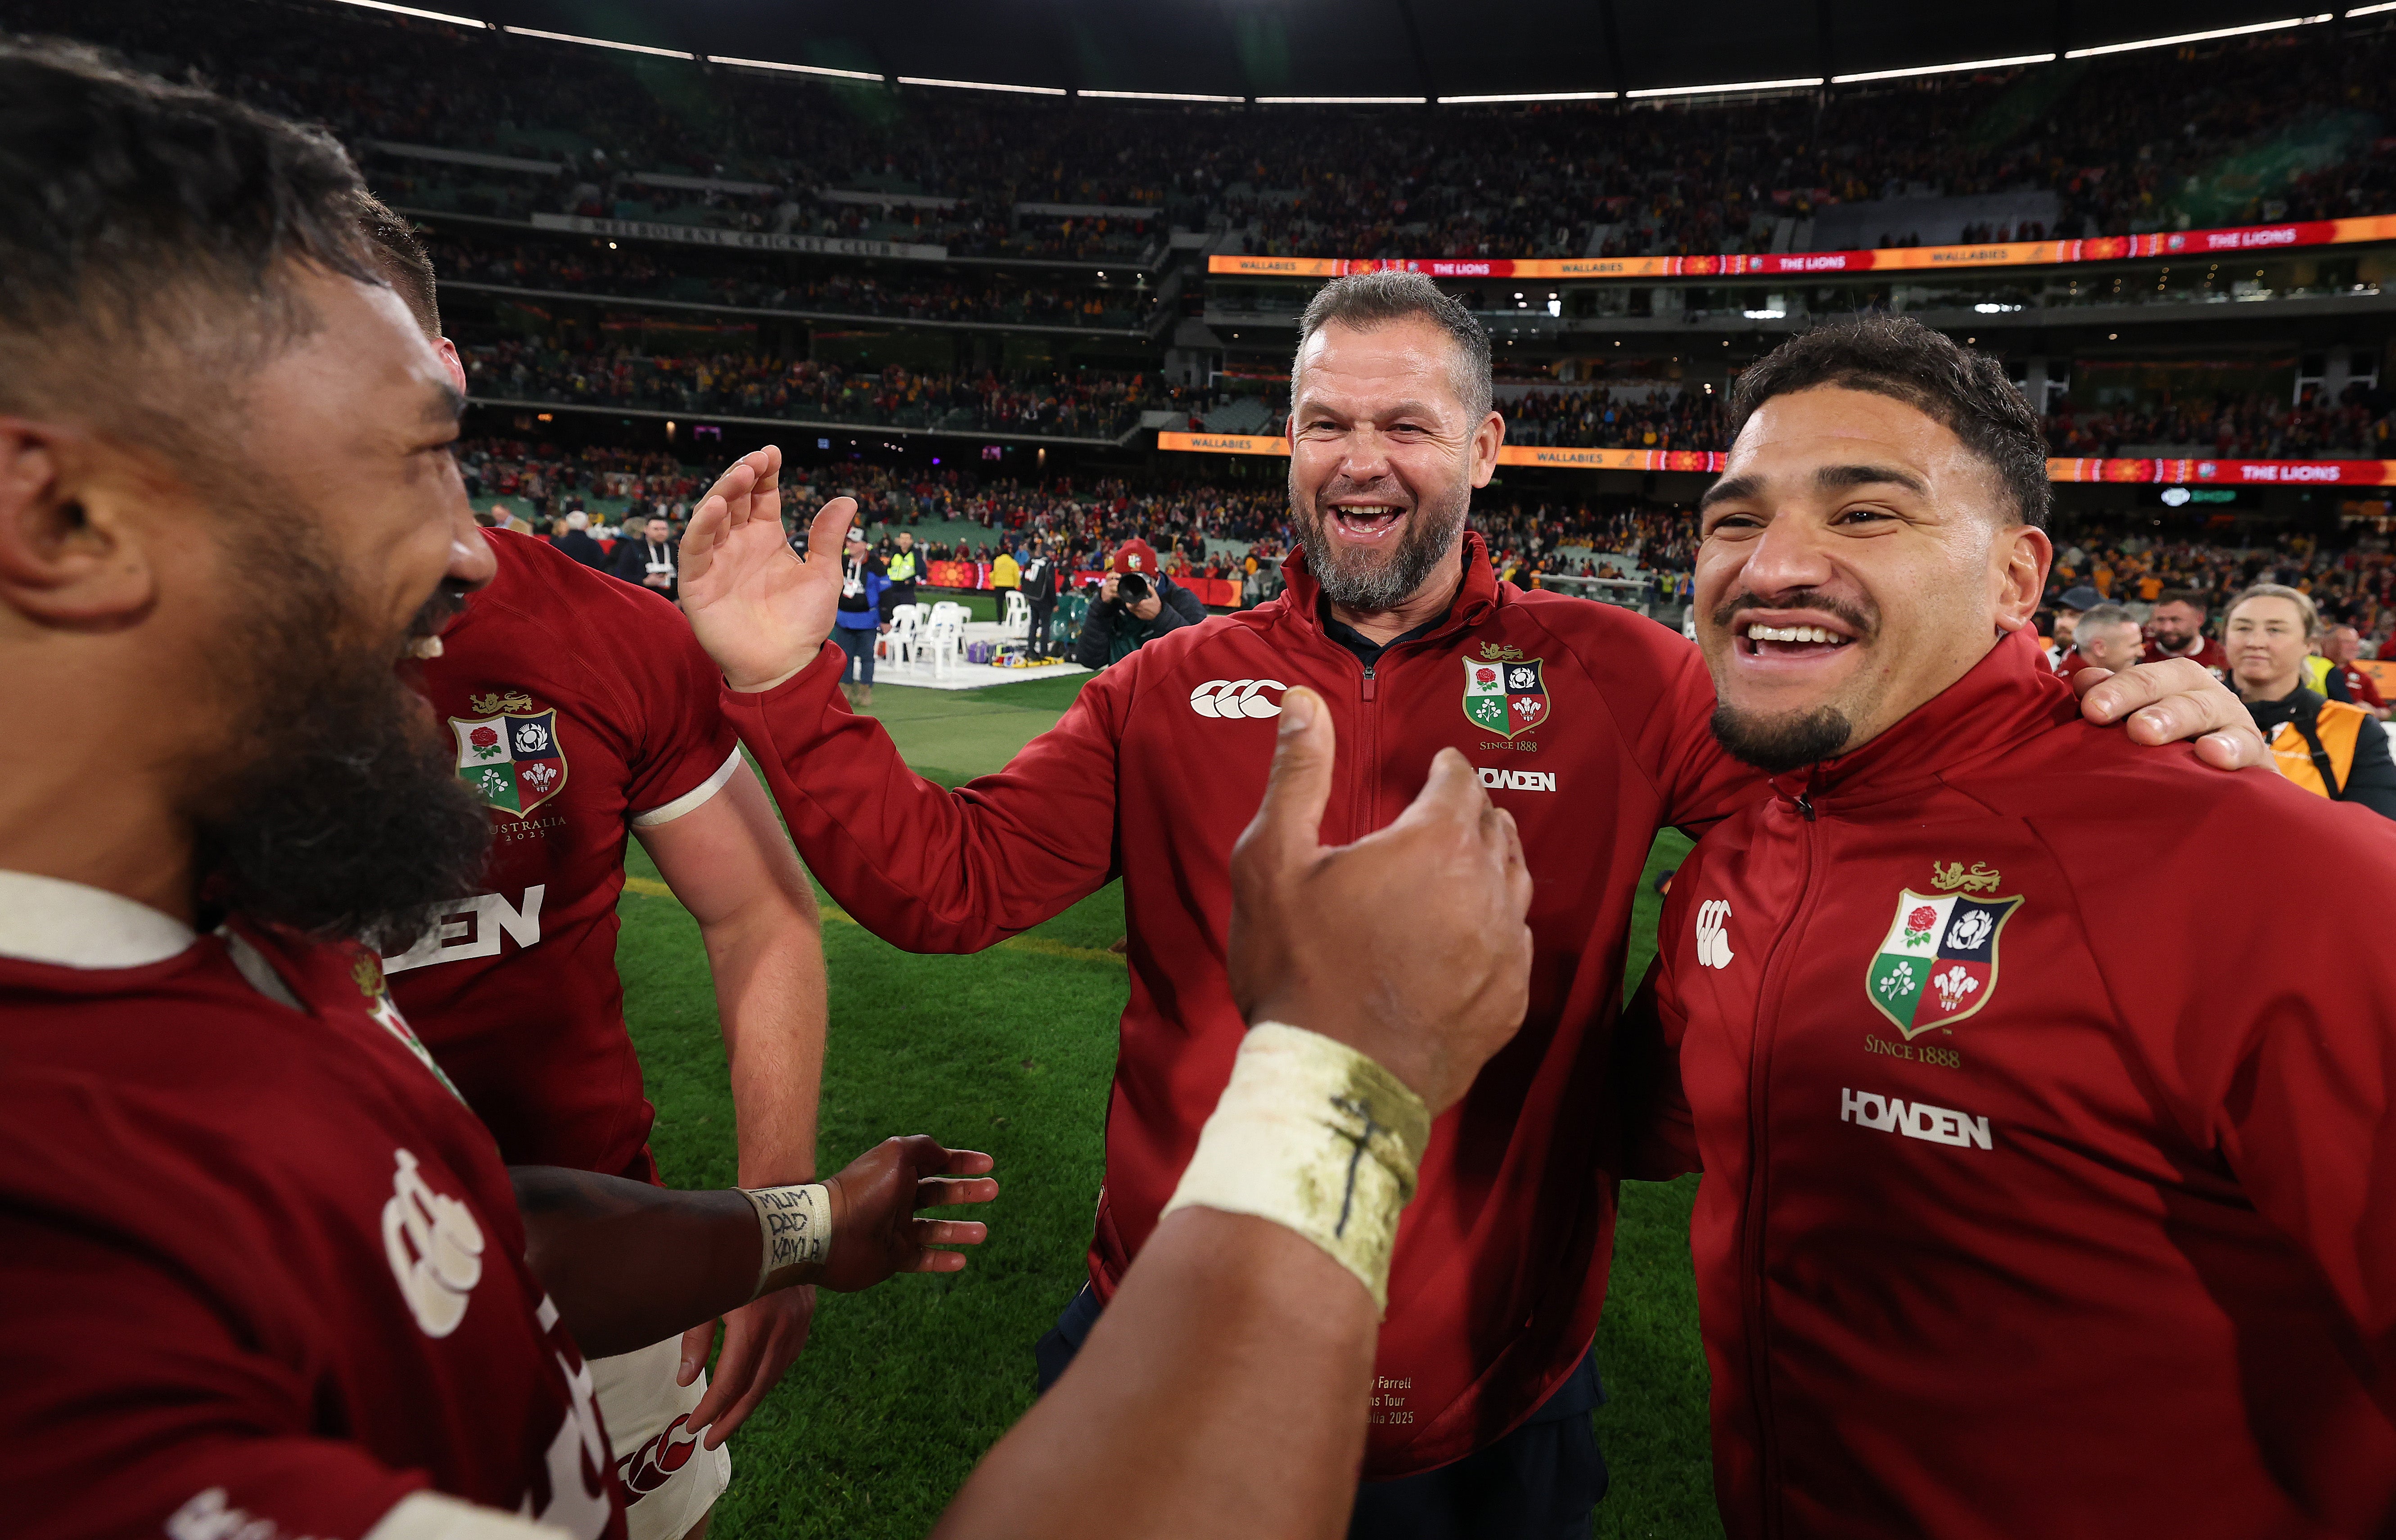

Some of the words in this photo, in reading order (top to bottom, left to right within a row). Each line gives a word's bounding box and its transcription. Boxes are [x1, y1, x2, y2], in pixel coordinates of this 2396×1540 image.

[2207, 232, 2241, 248] THE
[2242, 229, 2296, 246] LIONS
[1240, 261, 1296, 271] WALLABIES
[1433, 263, 1454, 275] THE
[1456, 263, 1489, 275] LIONS
[1780, 257, 1804, 270] THE
[1805, 256, 1846, 270] LIONS
[1191, 438, 1251, 450] WALLABIES
[1537, 452, 1603, 464] WALLABIES
[2240, 465, 2279, 480] THE
[2280, 465, 2340, 481] LIONS
[1480, 741, 1514, 750] SINCE
[1516, 741, 1537, 752] 1888
[1472, 767, 1556, 792] OWDEN
[489, 816, 566, 835] USTRALIA
[505, 830, 545, 842] 2025
[1864, 1034, 1914, 1060] SINCE
[1918, 1046, 1960, 1069] 1888
[1841, 1087, 1993, 1150] HOWDEN
[756, 1189, 814, 1210] MUM
[767, 1212, 808, 1235] DAD
[1378, 1376, 1412, 1389] Farrell
[1384, 1394, 1405, 1406] Tour
[1389, 1411, 1414, 1424] 2025
